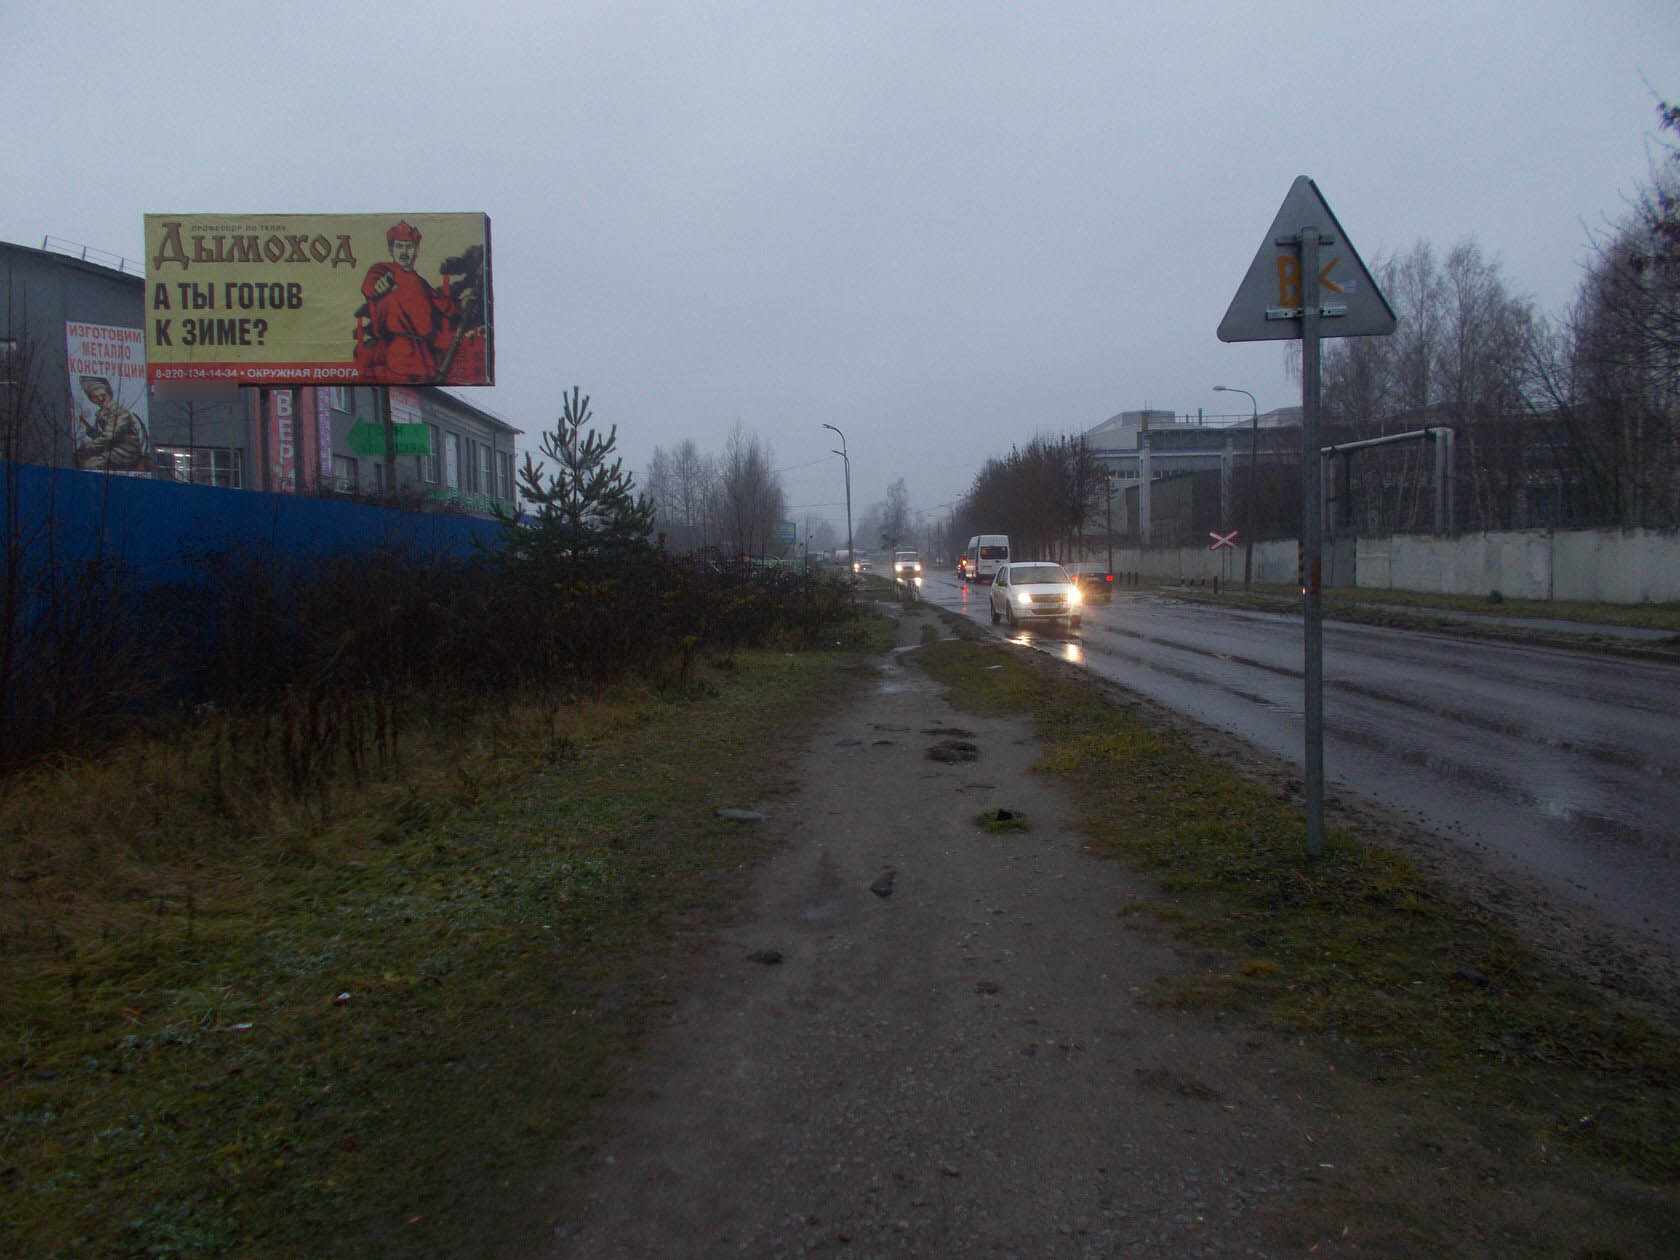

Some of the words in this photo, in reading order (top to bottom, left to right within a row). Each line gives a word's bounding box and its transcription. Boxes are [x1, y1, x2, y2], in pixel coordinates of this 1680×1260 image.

[153, 282, 171, 310] А
[178, 282, 215, 310] ТЫ
[224, 282, 304, 310] ГОТОВ
[68, 324, 142, 344] ИЗГОТОВИМ
[155, 318, 173, 346] К
[181, 318, 268, 346] ЗИМЕ?
[82, 341, 131, 360] МЕТАЛЛО
[68, 357, 145, 379] КОНСТРУКЦИИ
[247, 368, 311, 378] ОКРУЖНАЯ
[313, 368, 359, 379] ДОРОГА
